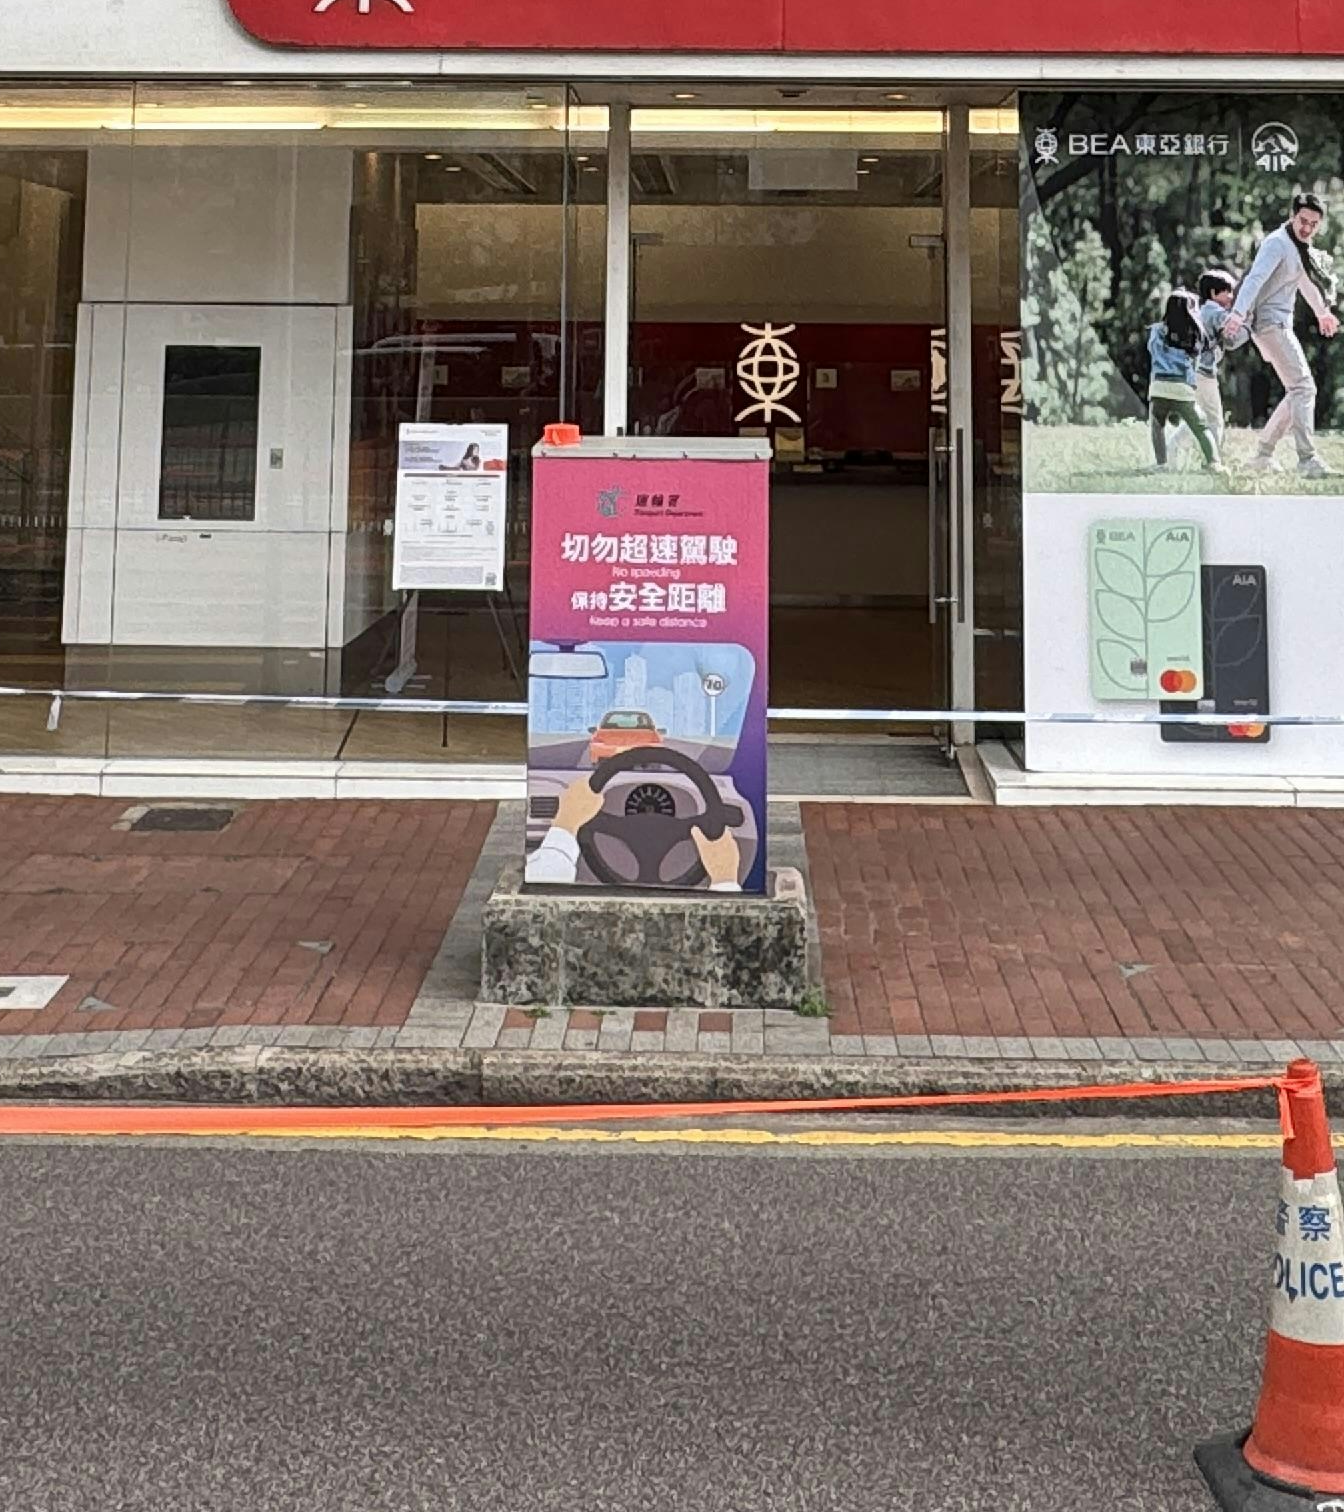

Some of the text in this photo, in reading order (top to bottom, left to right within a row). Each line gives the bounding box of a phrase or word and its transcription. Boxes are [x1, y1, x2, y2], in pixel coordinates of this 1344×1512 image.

[1068, 133, 1296, 172] BEA 東亞銀行 AIA
[560, 532, 738, 566] 切勿超速駕駛
[612, 567, 629, 578] No
[570, 581, 727, 613] 保持安全距離
